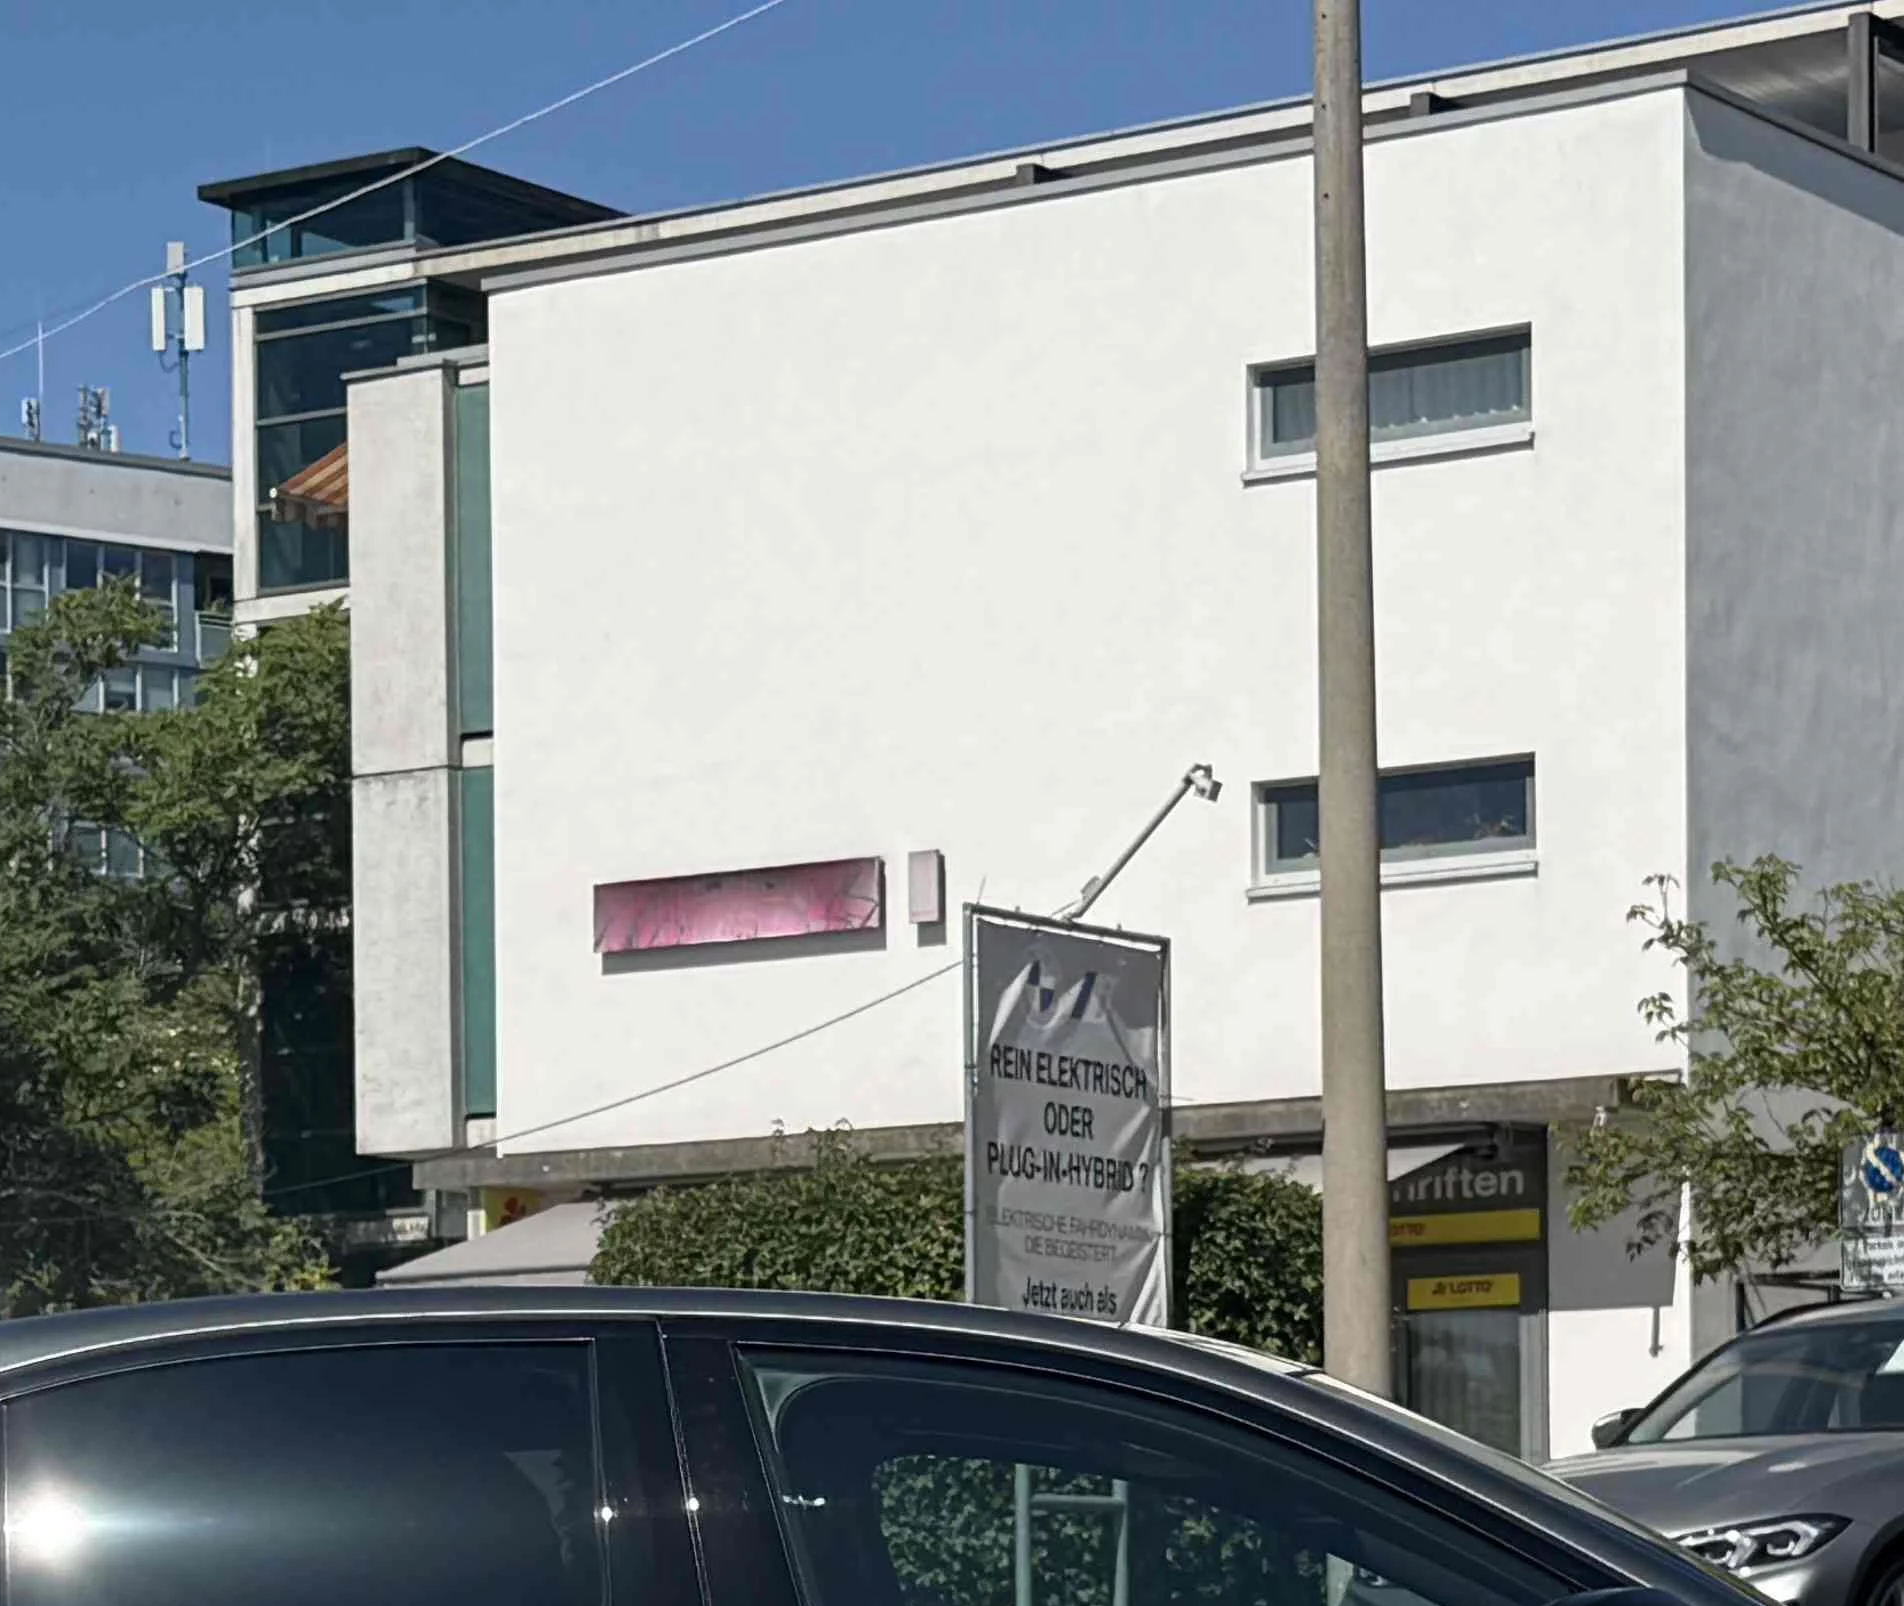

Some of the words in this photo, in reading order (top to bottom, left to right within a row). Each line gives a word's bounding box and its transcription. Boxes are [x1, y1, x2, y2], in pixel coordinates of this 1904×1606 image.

[990, 1043, 1032, 1082] REIN
[1036, 1052, 1148, 1098] ELEKTRISCH
[1044, 1102, 1095, 1140] ODER
[987, 1141, 1134, 1192] PLUG-IN-HYBRID
[1022, 1276, 1057, 1308] Jetzt
[1061, 1281, 1094, 1312] auch
[1097, 1284, 1117, 1315] als
[1449, 1280, 1494, 1294] LOTTO
